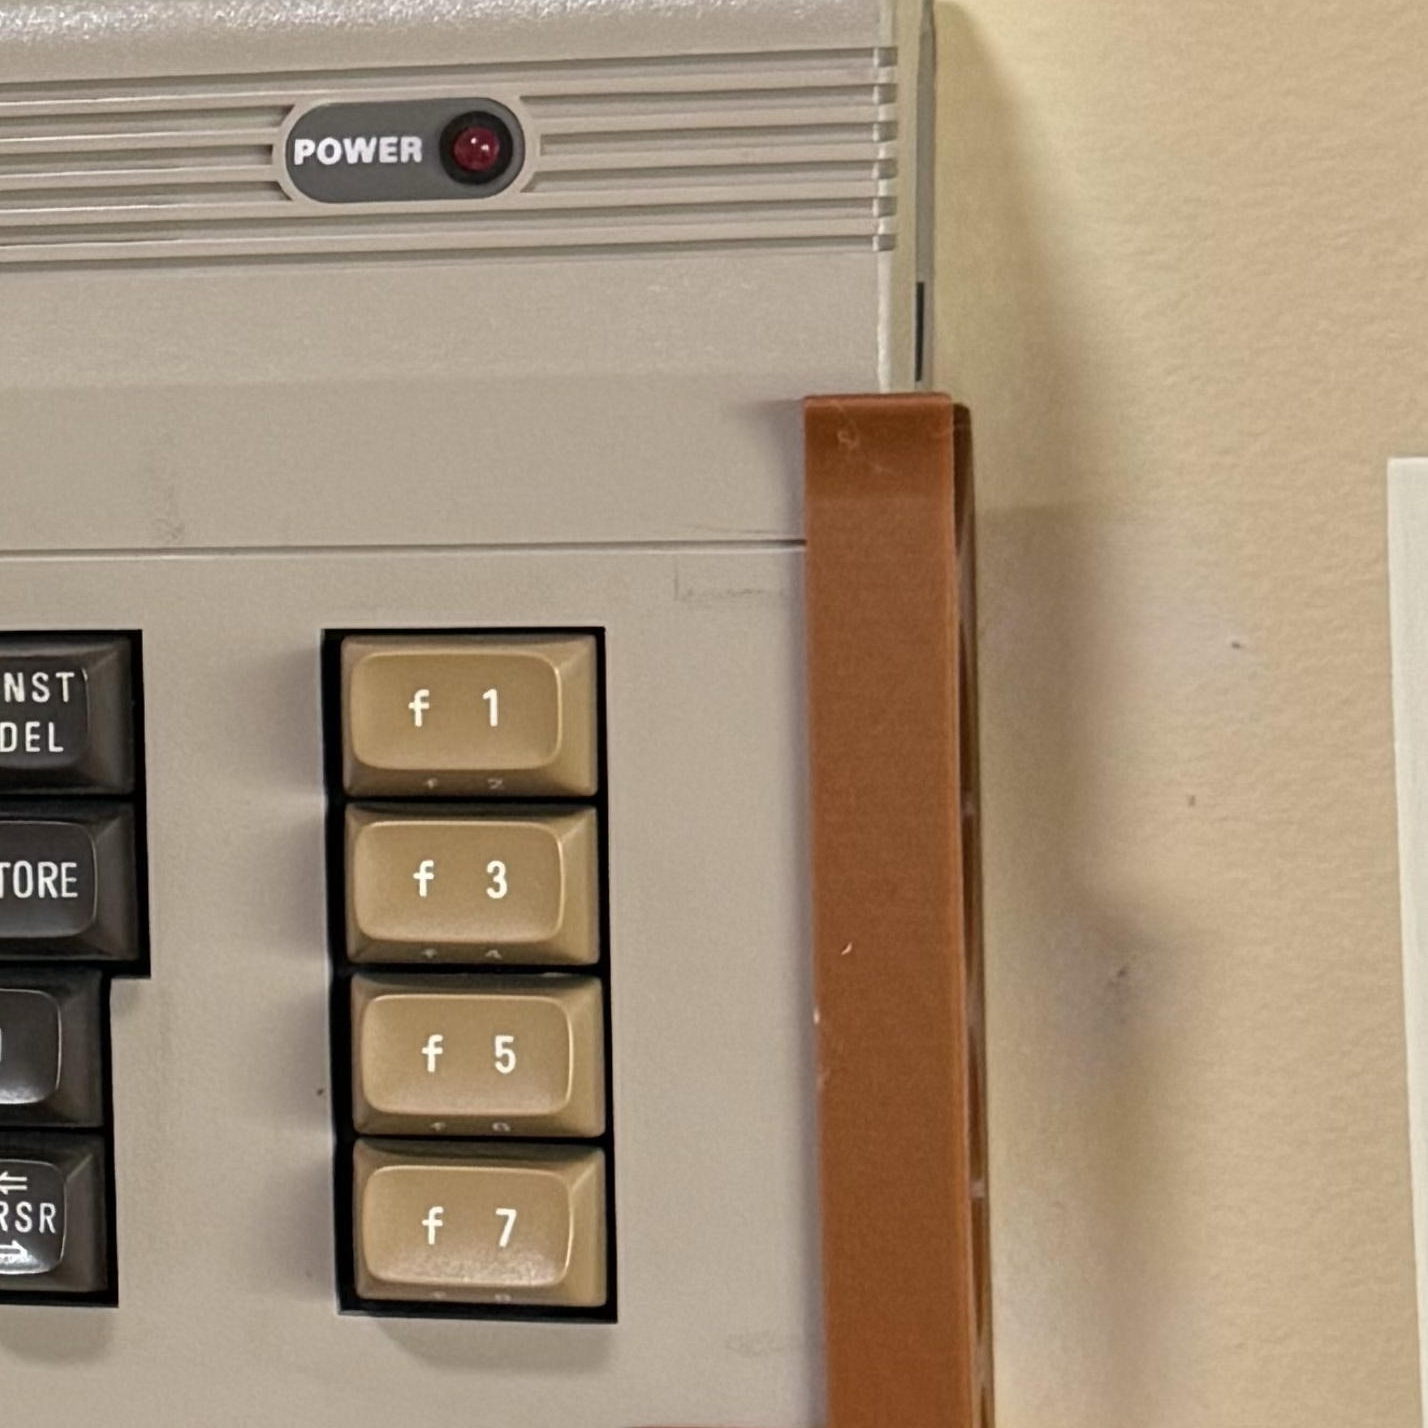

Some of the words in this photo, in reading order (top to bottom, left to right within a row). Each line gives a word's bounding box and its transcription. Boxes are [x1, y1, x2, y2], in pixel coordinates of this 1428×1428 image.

[293, 136, 422, 166] POWER
[408, 689, 430, 727] f
[482, 688, 498, 727] 1
[412, 859, 435, 897] f
[486, 860, 508, 899] 3
[421, 1034, 444, 1073] f
[494, 1035, 517, 1074] 5
[421, 1206, 444, 1245] f
[495, 1207, 517, 1248] 7
